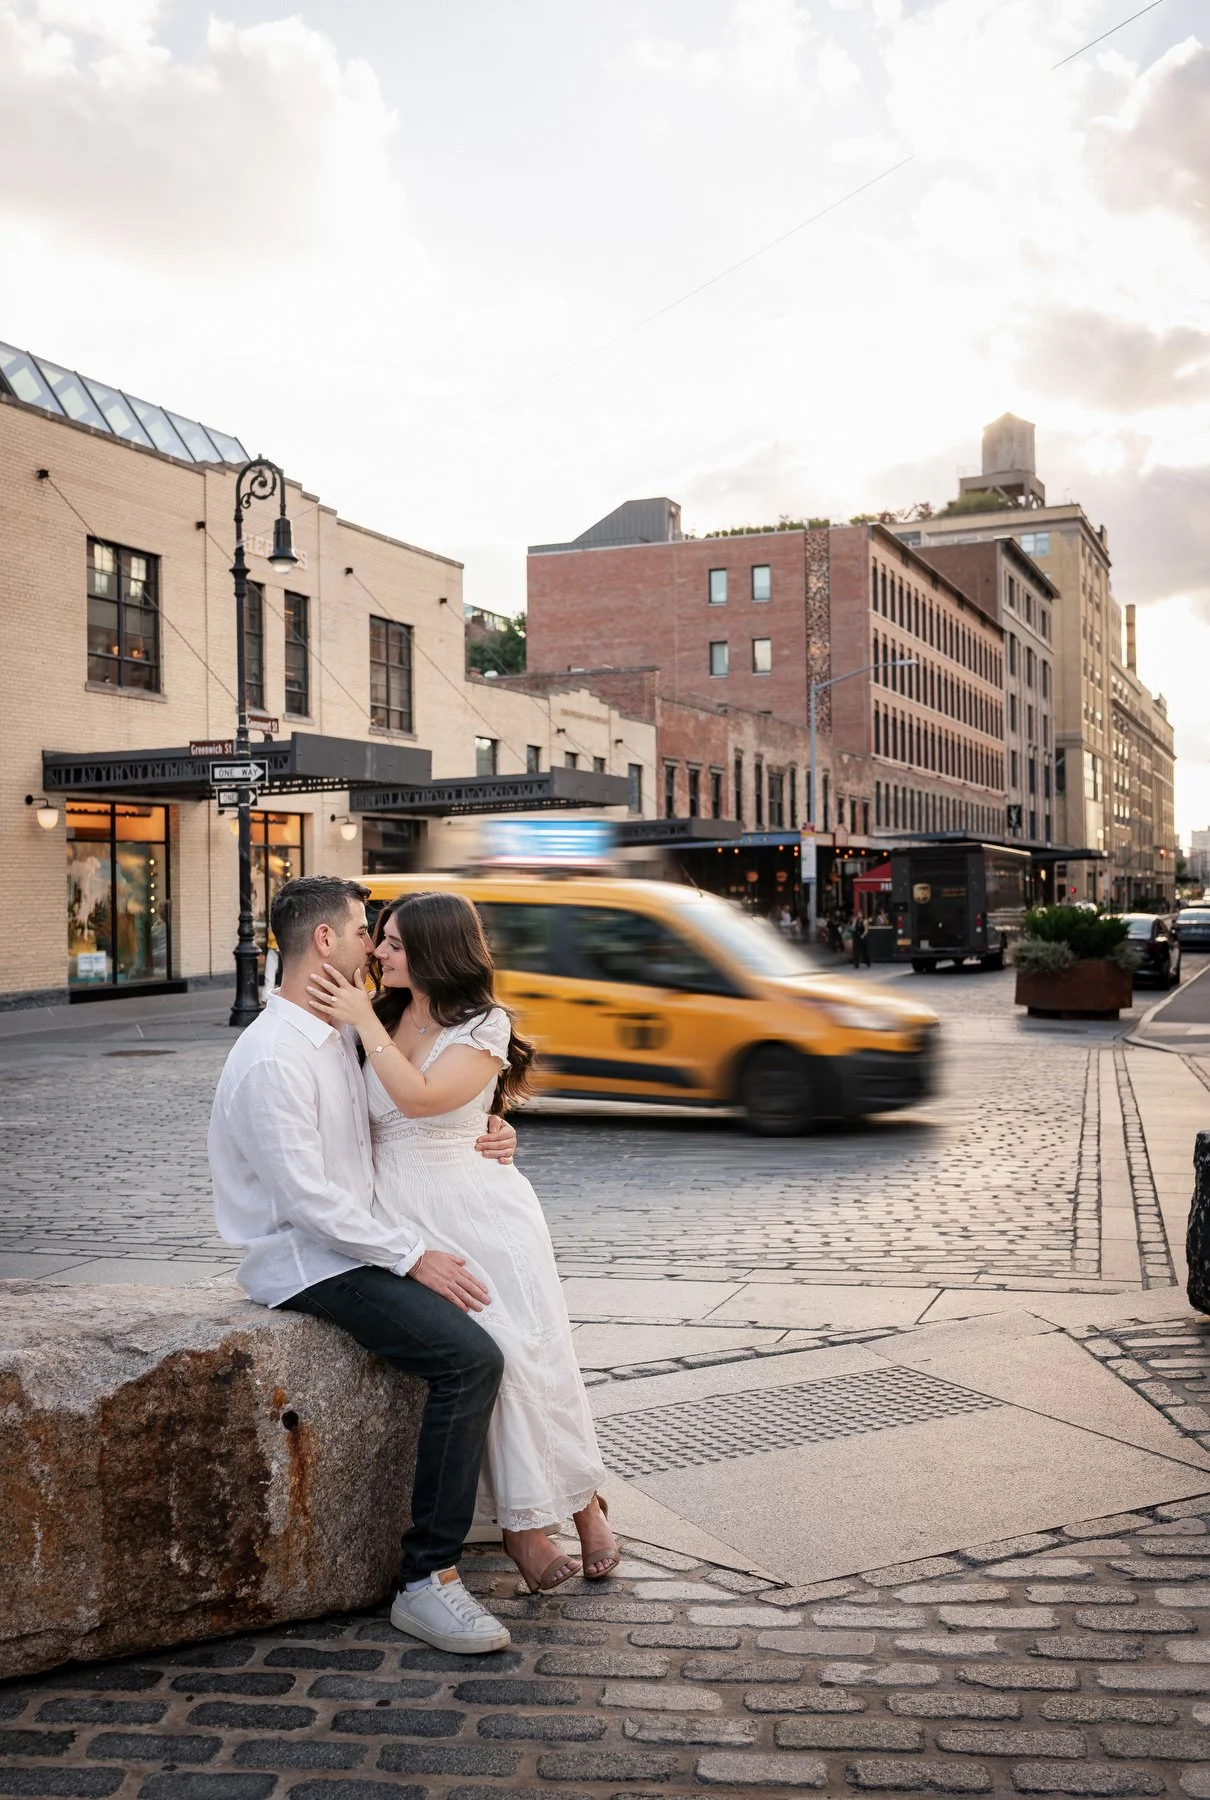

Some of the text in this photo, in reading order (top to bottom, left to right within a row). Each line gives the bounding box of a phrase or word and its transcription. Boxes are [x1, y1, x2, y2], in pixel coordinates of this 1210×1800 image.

[191, 743, 232, 755] Greenwich St
[219, 768, 258, 777] ONE WAY
[222, 793, 235, 801] ONE
